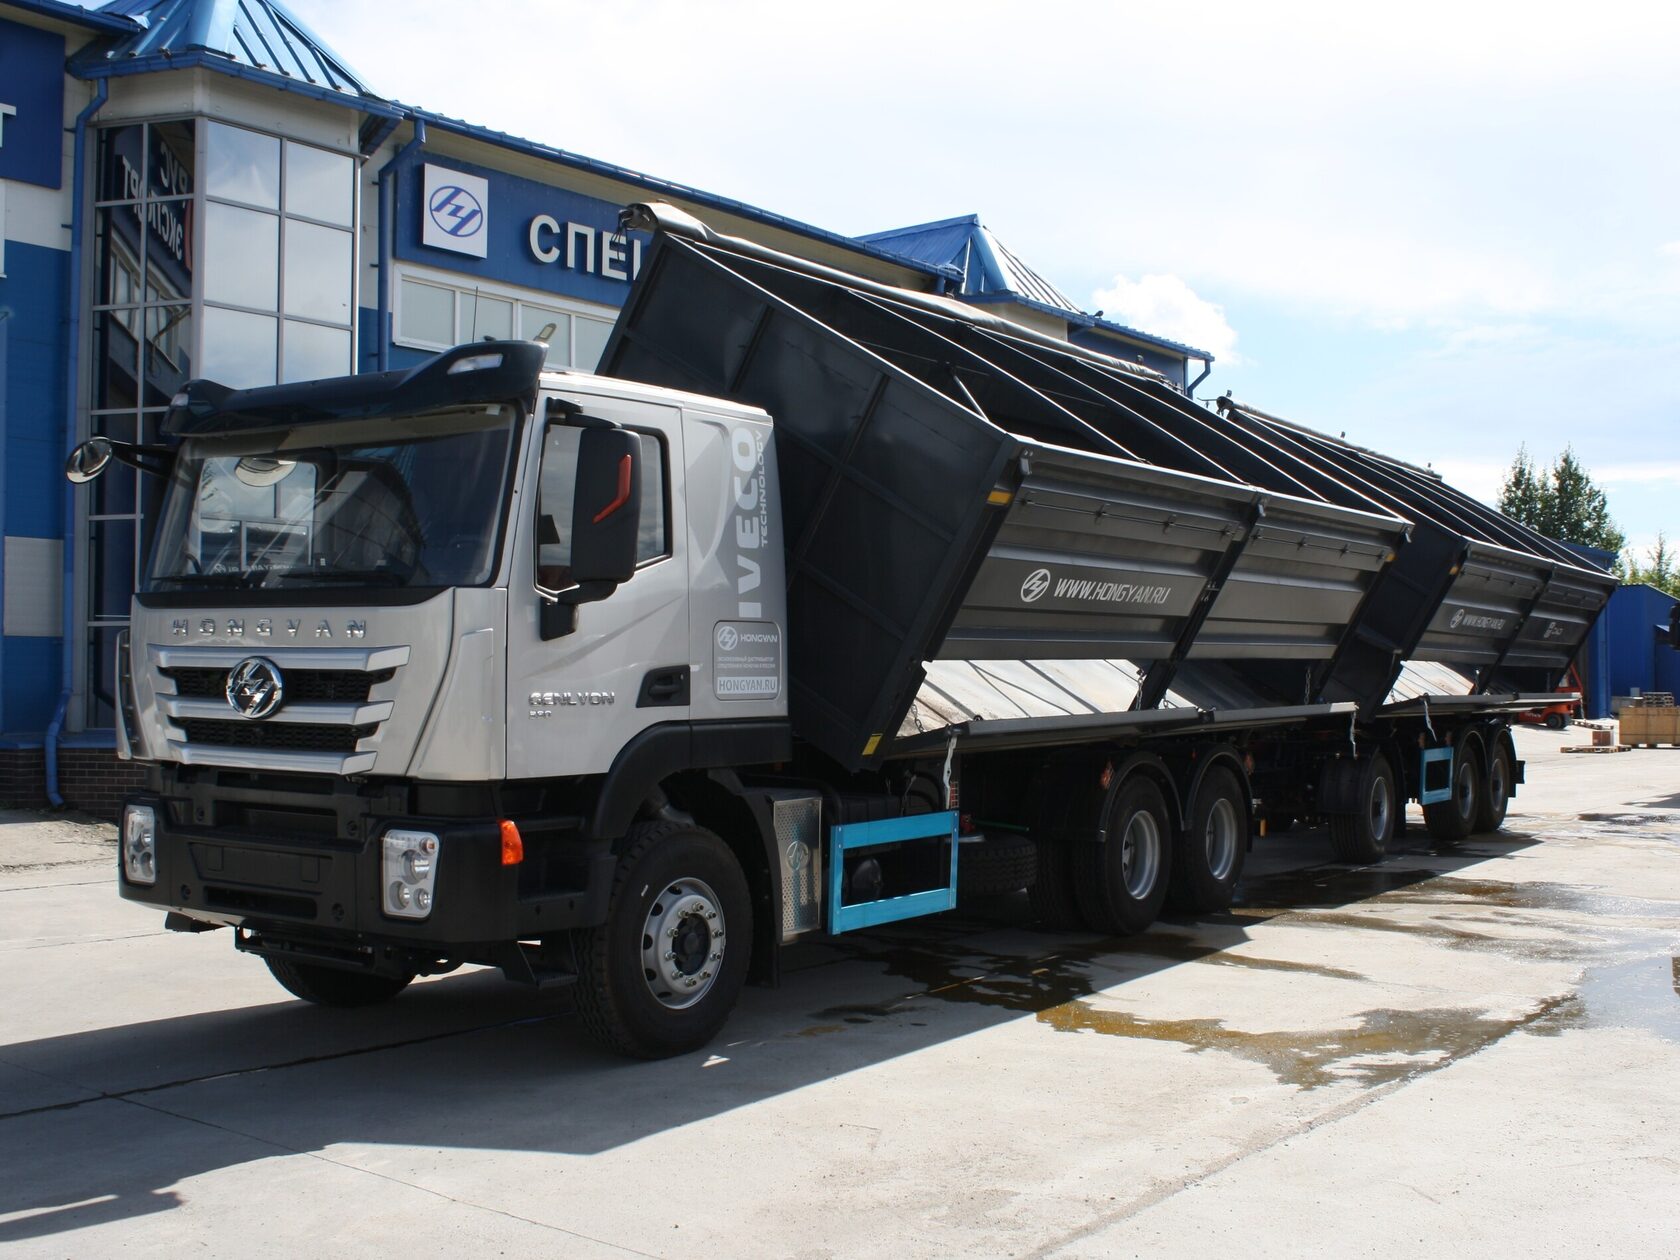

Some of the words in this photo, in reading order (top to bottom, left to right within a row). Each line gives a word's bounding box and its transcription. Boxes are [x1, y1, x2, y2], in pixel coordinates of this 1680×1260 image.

[756, 430, 768, 547] TECHNOLOGY
[731, 427, 761, 618] IVECO
[1054, 578, 1171, 604] WWW.HONGYAN.RU
[740, 633, 778, 643] HONGYAN
[719, 679, 776, 691] HONGYAN.RU
